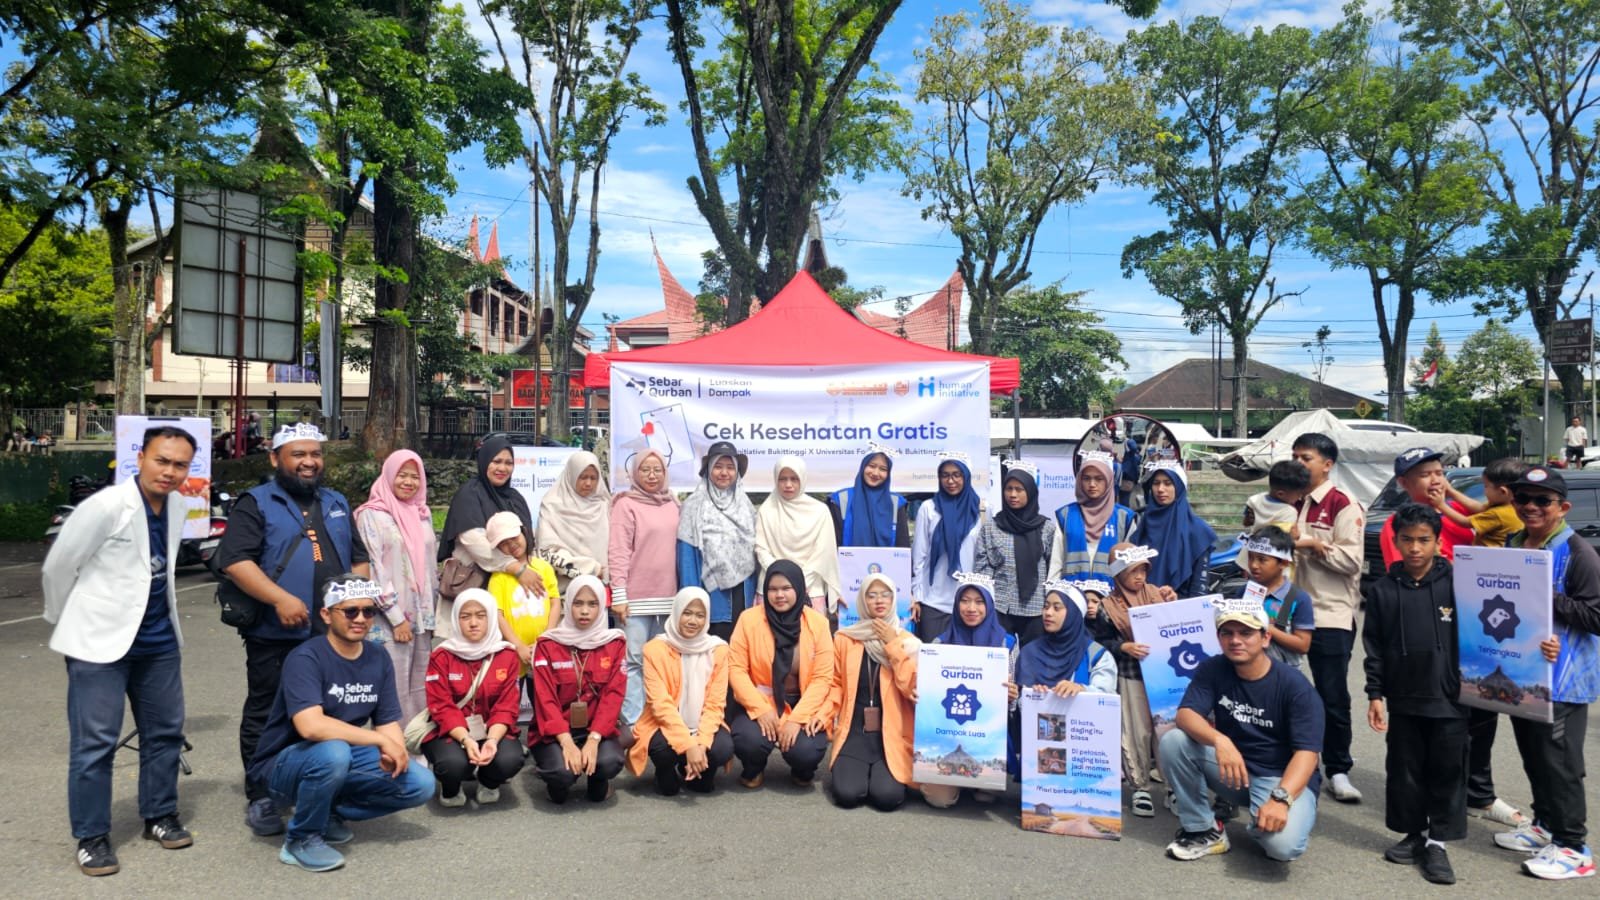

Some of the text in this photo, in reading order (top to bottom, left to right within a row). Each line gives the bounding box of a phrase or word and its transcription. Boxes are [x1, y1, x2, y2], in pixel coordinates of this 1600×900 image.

[648, 376, 683, 387] Sebar
[709, 378, 753, 387] Luaskan
[939, 380, 973, 389] human
[648, 387, 692, 398] Qurban
[708, 388, 752, 399] Dampak
[939, 389, 981, 398] initiative
[703, 421, 948, 440] Cek Kesehatan Gratis
[767, 447, 807, 457] Bukittinggi
[1043, 473, 1074, 481] human
[1043, 481, 1075, 489] initiativ
[1476, 577, 1520, 590] Qurban
[348, 588, 381, 597] Qurban
[1159, 624, 1204, 639] Qurban
[1478, 645, 1521, 659] Terjangkau
[941, 669, 983, 680] Qurban
[345, 682, 374, 693] Sebar
[344, 692, 378, 705] Qurban
[1233, 709, 1274, 728] Qurban
[935, 727, 986, 738] Dampak Luas
[1070, 727, 1093, 735] daging
[1071, 756, 1094, 765] daging
[1071, 763, 1084, 771] jadi
[1053, 787, 1079, 795] berbagi
